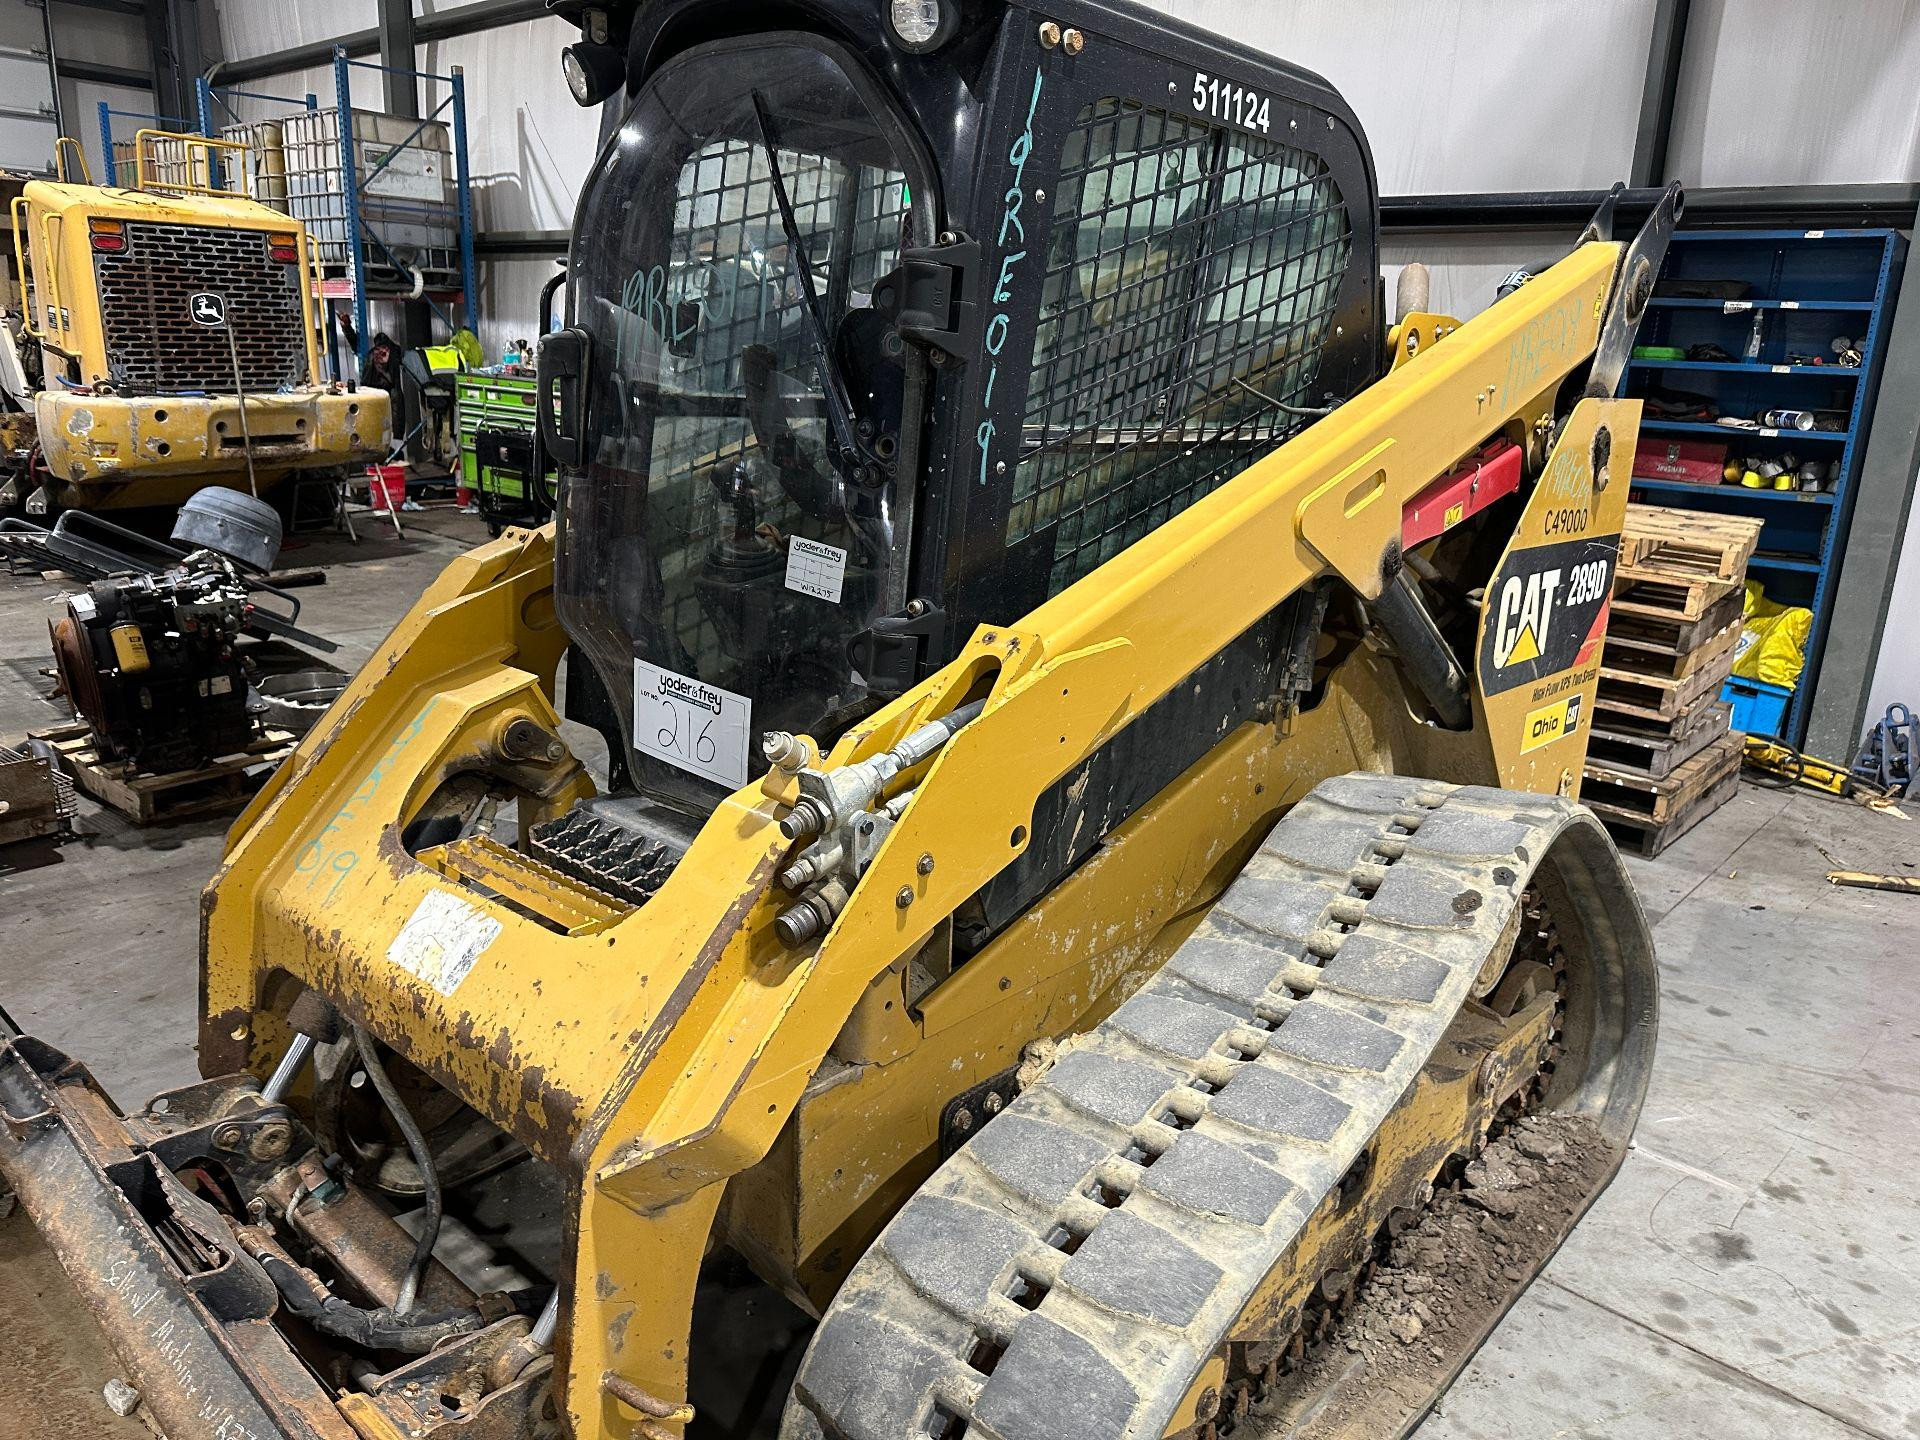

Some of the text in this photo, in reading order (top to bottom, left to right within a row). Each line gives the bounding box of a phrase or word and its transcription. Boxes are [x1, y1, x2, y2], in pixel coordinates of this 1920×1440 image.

[1192, 72, 1270, 134] 511124
[1544, 508, 1588, 535] C49000
[1493, 560, 1607, 670] CAT 289D
[640, 689, 651, 698] LOT
[657, 700, 716, 763] 216
[1532, 704, 1580, 738] Ohio CAT
